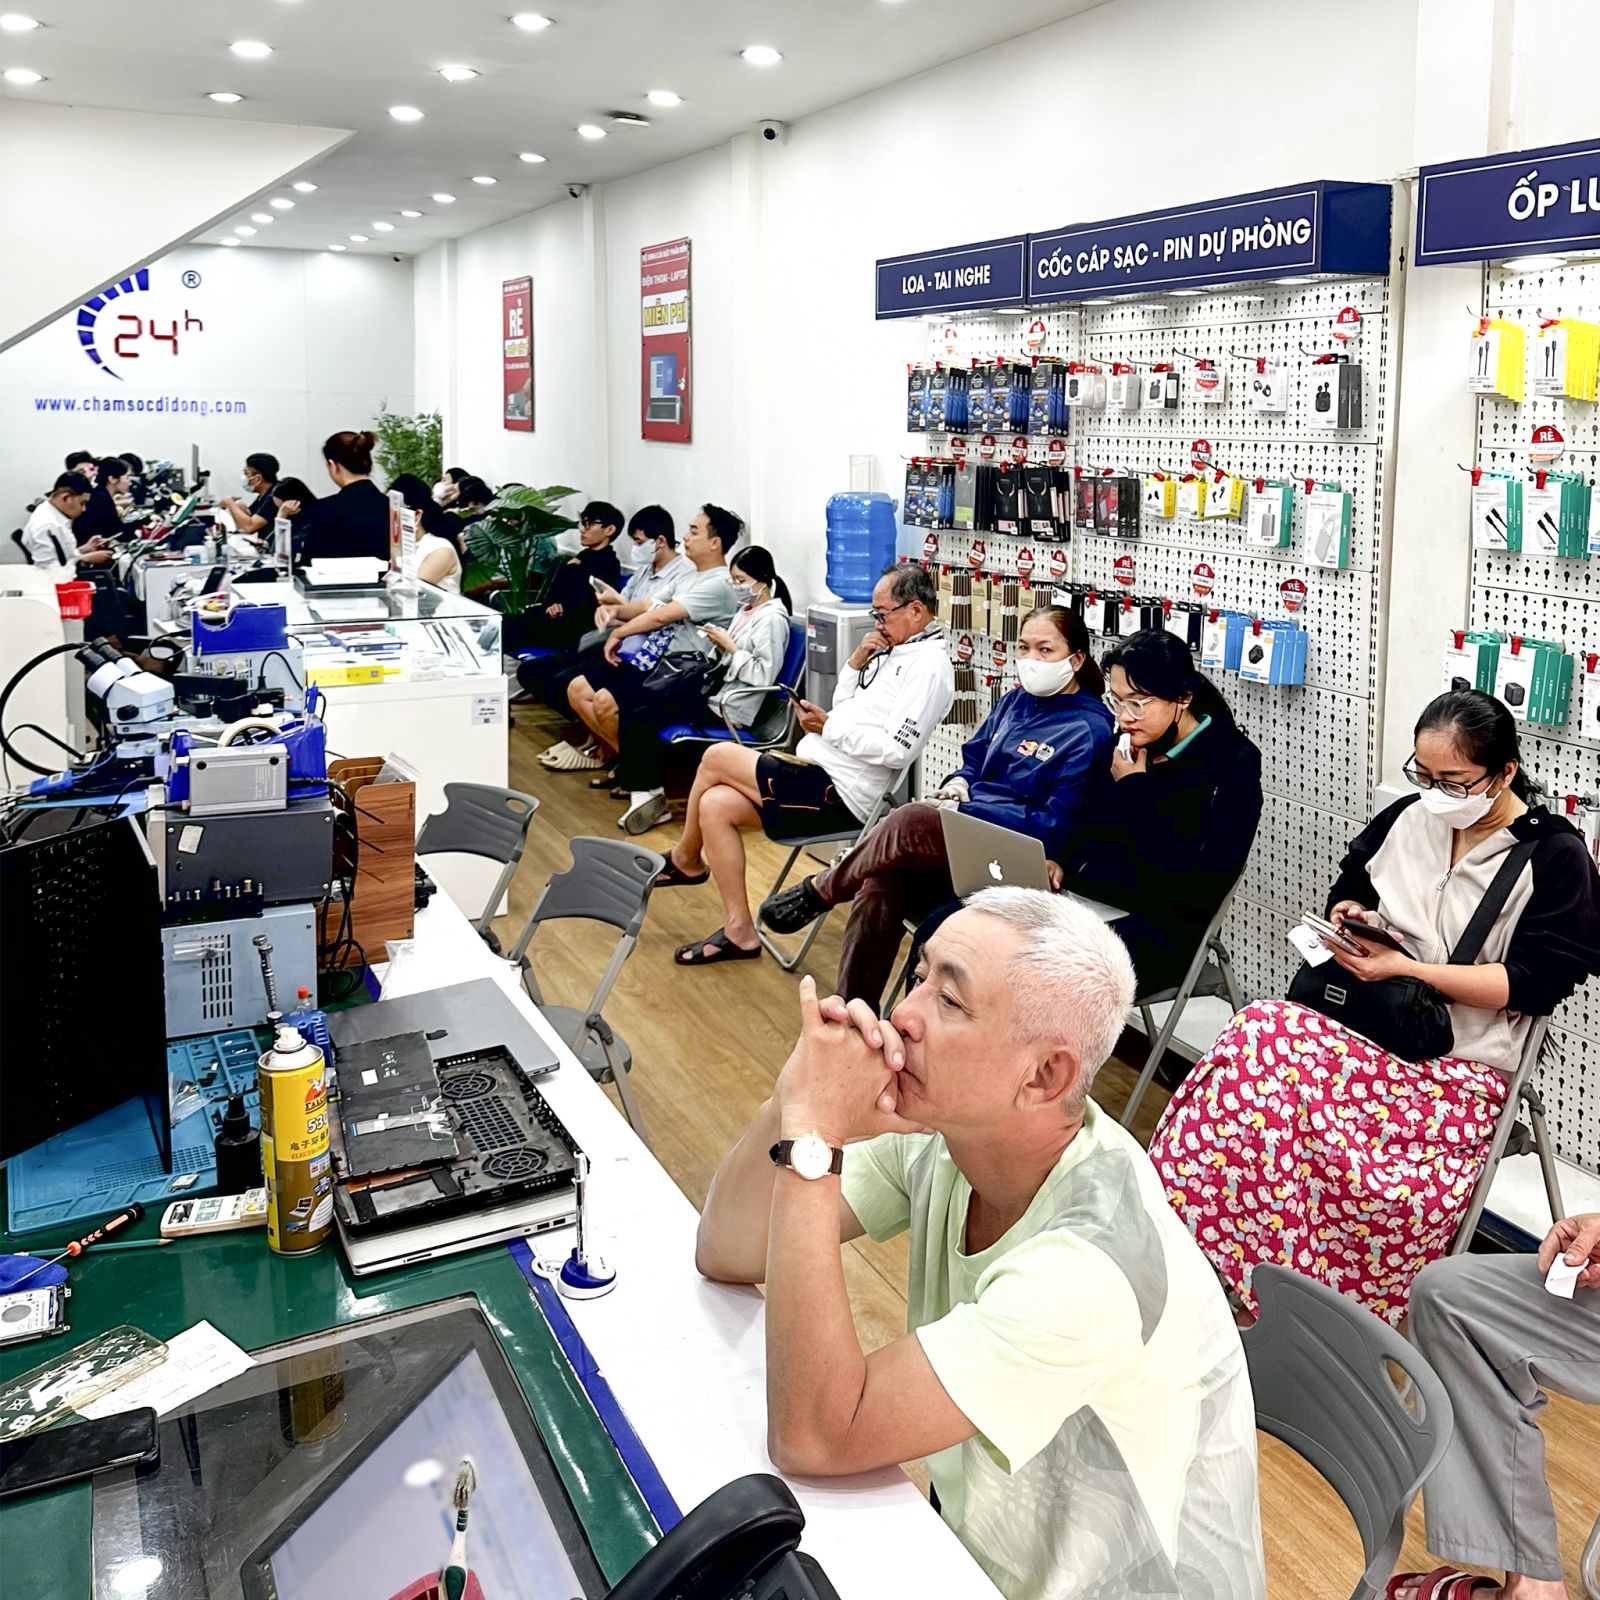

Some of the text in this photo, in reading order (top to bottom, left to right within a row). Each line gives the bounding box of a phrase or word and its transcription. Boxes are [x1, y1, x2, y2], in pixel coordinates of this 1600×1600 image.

[1507, 170, 1559, 221] ỐP
[1037, 246, 1073, 279] CỐC
[1076, 243, 1111, 274] CÁP
[1113, 242, 1149, 274] SẠC
[1163, 235, 1194, 262] PIN
[1198, 226, 1229, 262] DỰ
[1231, 216, 1312, 253] PHÒNG
[902, 273, 926, 295] LOA
[934, 268, 953, 291] TAI
[954, 264, 991, 288] NGHE
[509, 298, 524, 338] RẺ
[34, 395, 247, 417] www.chamsocdidong.com
[1539, 428, 1555, 442] RẺ
[1287, 580, 1301, 591] RẺ
